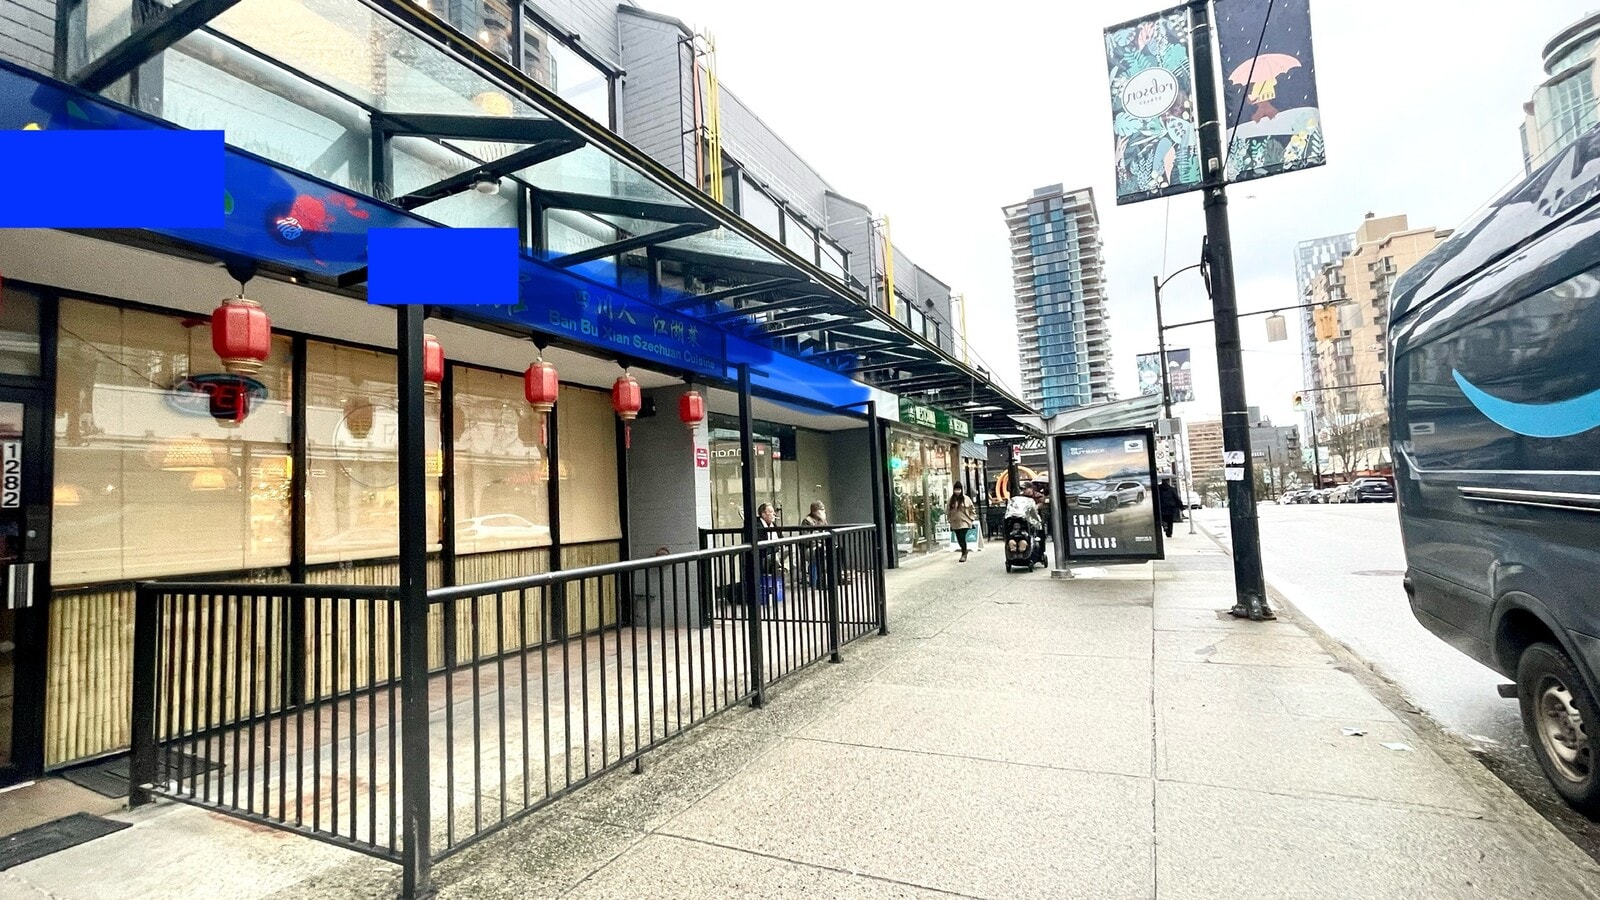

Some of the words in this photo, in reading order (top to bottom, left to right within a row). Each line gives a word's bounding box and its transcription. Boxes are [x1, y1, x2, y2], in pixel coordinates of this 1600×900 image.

[548, 308, 577, 332] Ban
[580, 318, 599, 338] Bu
[602, 324, 630, 346] Xian
[632, 334, 682, 361] Szechuan
[683, 349, 716, 370] Cuisine
[4, 443, 20, 507] 1282
[1072, 513, 1105, 526] ENJOY
[1074, 526, 1092, 538] ALL
[1074, 537, 1117, 550] WORLDS
